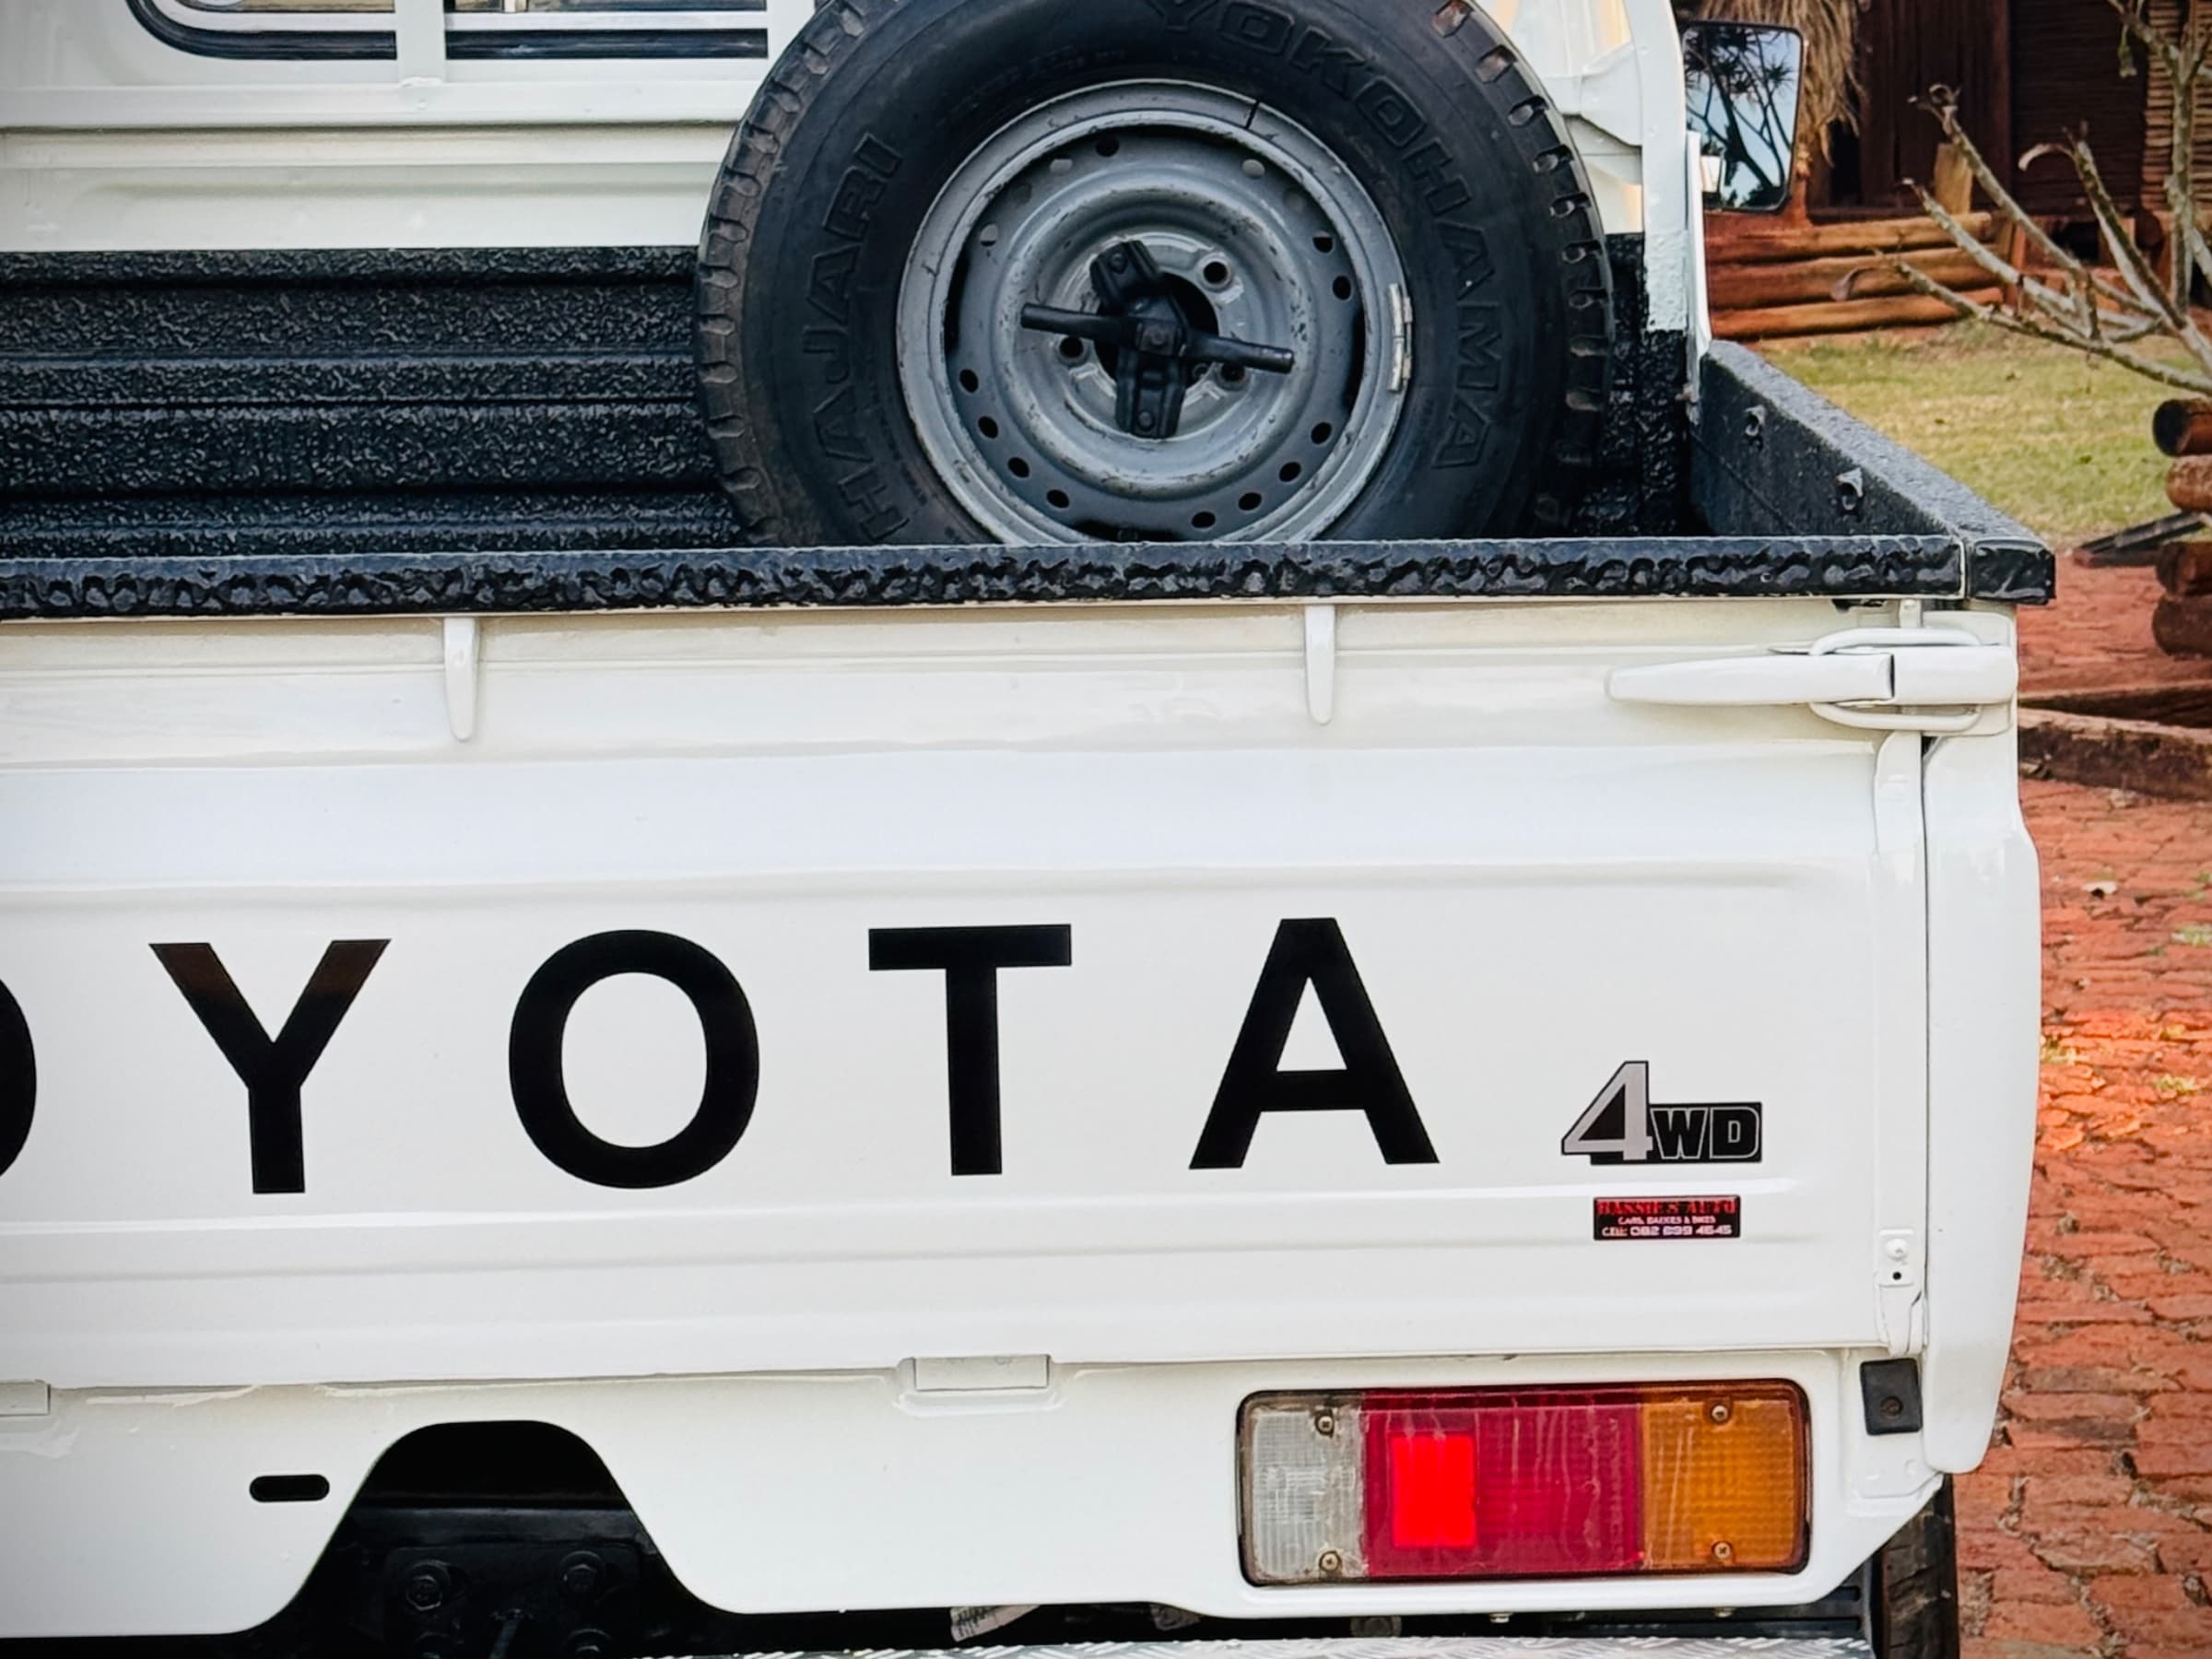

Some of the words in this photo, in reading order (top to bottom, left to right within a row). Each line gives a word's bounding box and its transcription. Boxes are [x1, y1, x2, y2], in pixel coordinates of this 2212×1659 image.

[802, 132, 911, 542] HAJARI
[1152, 0, 1502, 469] YOKOHAMA
[0, 918, 1439, 1194] YOTA
[1561, 1061, 1761, 1165] 4WD
[1686, 1199, 1736, 1213] AUTO
